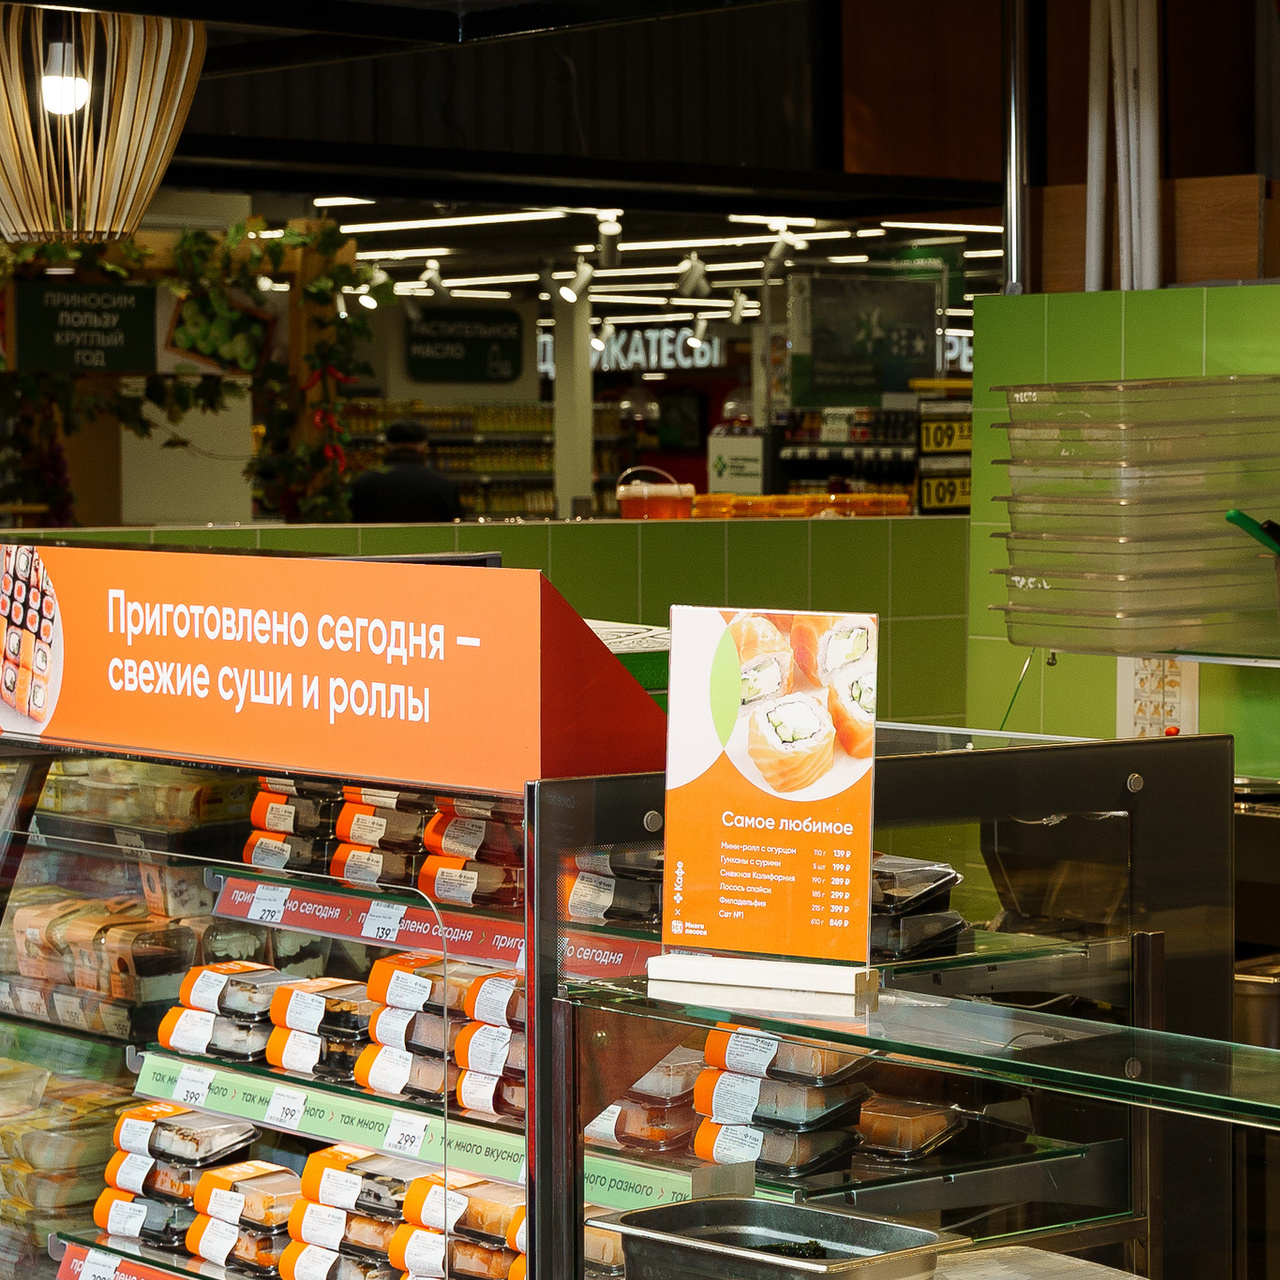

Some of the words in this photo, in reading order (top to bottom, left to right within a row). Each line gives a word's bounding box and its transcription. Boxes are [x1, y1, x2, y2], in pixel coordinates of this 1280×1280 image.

[43, 292, 136, 310] ПРИНОСИМ
[58, 311, 120, 328] ПОЛЬЗУ
[54, 328, 125, 347] КРУГЛЫЙ
[74, 349, 106, 367] ГОД
[924, 424, 956, 448] 109
[925, 481, 956, 505] 109
[108, 588, 309, 646] Приготовлено
[317, 614, 445, 665] сегодня
[108, 656, 210, 698] свежие
[217, 667, 293, 713] суши
[302, 676, 320, 709] и
[329, 677, 430, 724] роллы
[721, 810, 775, 831] Самое
[779, 816, 854, 836] любимое
[721, 841, 760, 852] Мини-ролл
[674, 861, 685, 891] Кафе
[832, 863, 845, 871] 199
[719, 882, 745, 892] Лосось
[830, 890, 844, 899] 299
[300, 902, 341, 919] сегодня
[719, 896, 767, 908] Филадельфия
[830, 905, 843, 913] 399
[259, 909, 276, 921] 279
[718, 909, 732, 918] Сет
[829, 918, 843, 927] 849
[375, 926, 391, 939] 139
[576, 947, 623, 965] сегодня
[183, 1090, 200, 1103] 399
[152, 1071, 166, 1083] так
[241, 1091, 256, 1104] так
[340, 1114, 354, 1126] так
[356, 1118, 384, 1133] много
[454, 1140, 483, 1155] много
[281, 1106, 296, 1120] 199
[397, 1133, 416, 1147] 299
[608, 1177, 653, 1197] разного
